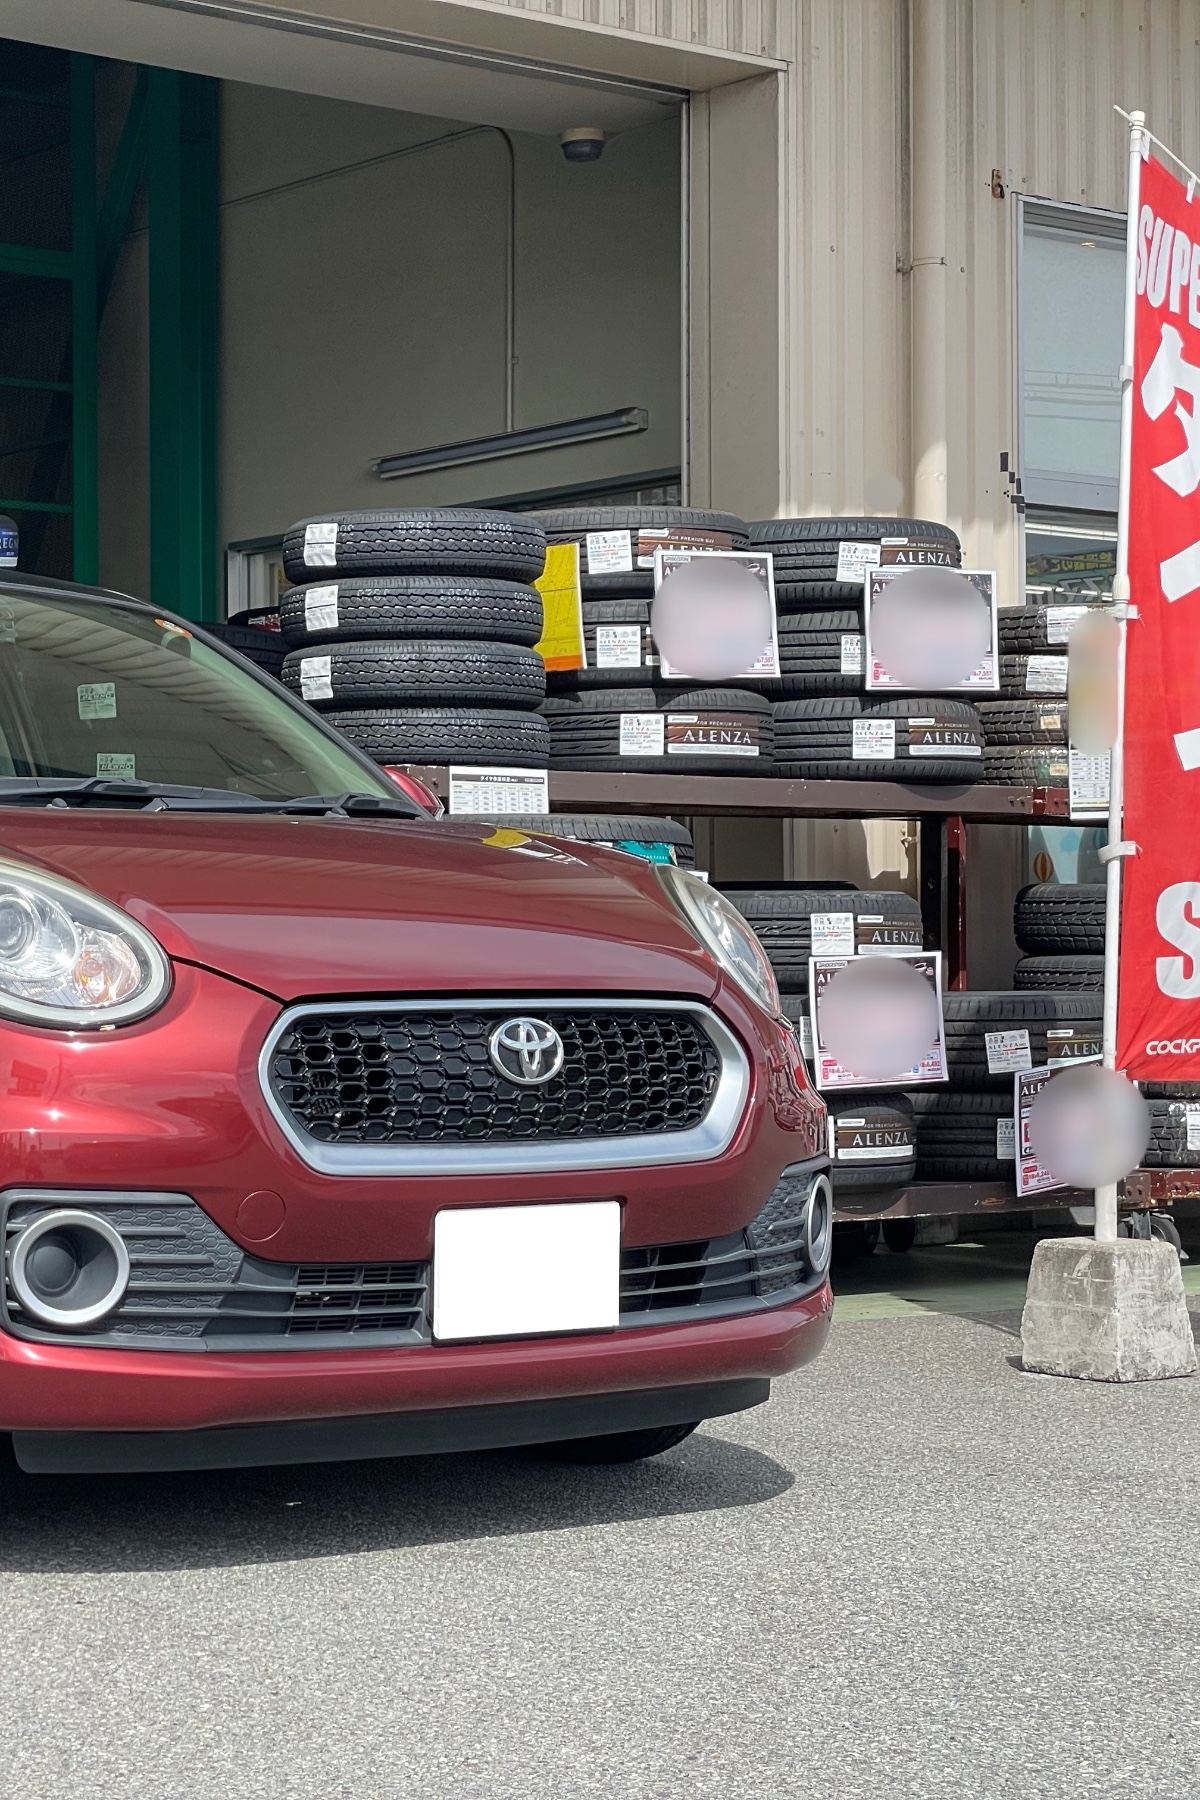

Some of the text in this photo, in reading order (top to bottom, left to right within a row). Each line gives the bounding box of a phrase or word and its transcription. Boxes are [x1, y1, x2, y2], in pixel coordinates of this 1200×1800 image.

[896, 552, 952, 565] ALENZA
[683, 730, 751, 744] ALENZA
[922, 731, 977, 744] ALENZA
[871, 930, 920, 943] ALENZA
[1021, 1082, 1048, 1096] ALE
[852, 1131, 909, 1146] ALENZA
